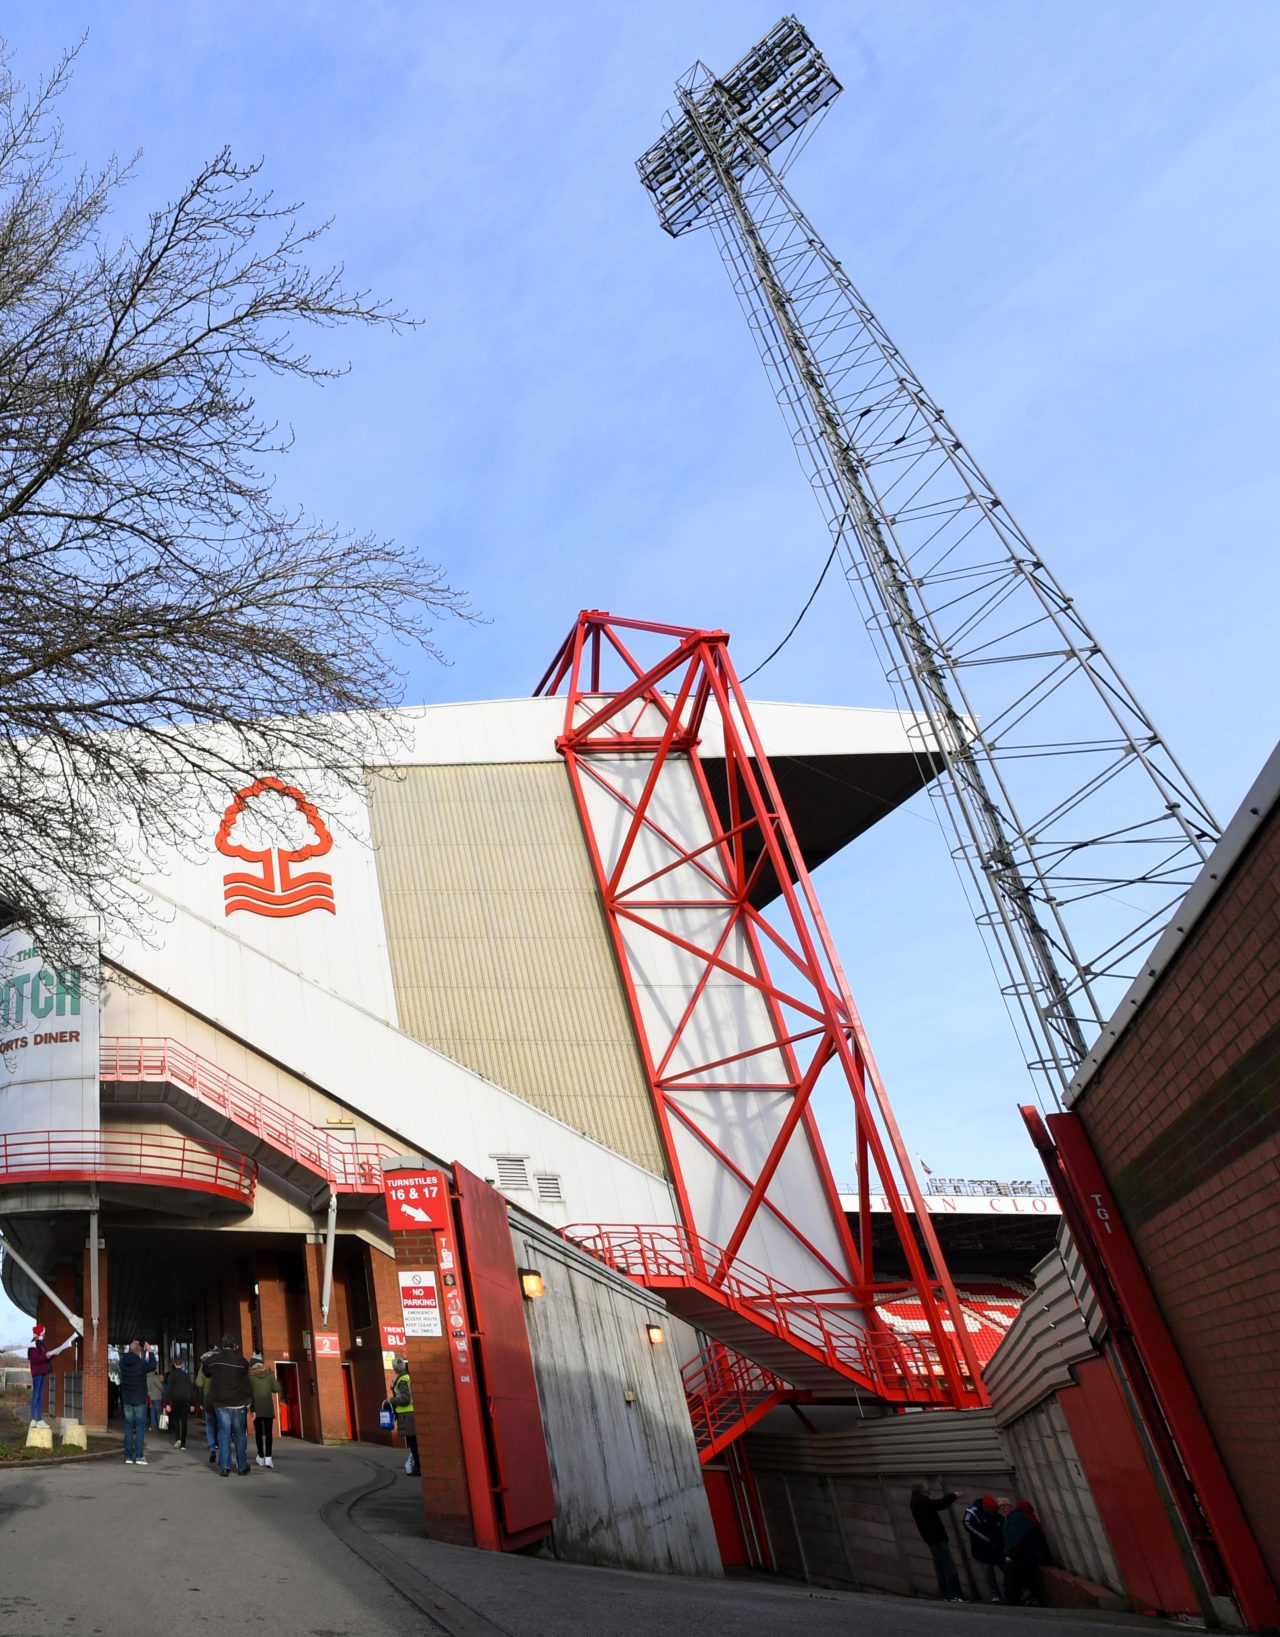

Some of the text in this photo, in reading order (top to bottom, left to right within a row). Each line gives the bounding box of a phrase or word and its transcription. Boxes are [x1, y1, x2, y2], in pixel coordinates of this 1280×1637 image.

[17, 948, 40, 962] THE
[34, 1030, 81, 1046] DINER
[387, 1176, 438, 1188] TURNSTILES
[390, 1186, 438, 1201] 16 & 17
[989, 1198, 1054, 1213] CLO
[412, 1288, 424, 1296] NO
[403, 1298, 436, 1306] PARKING
[322, 1339, 331, 1352] 2
[387, 1334, 406, 1346] BL
